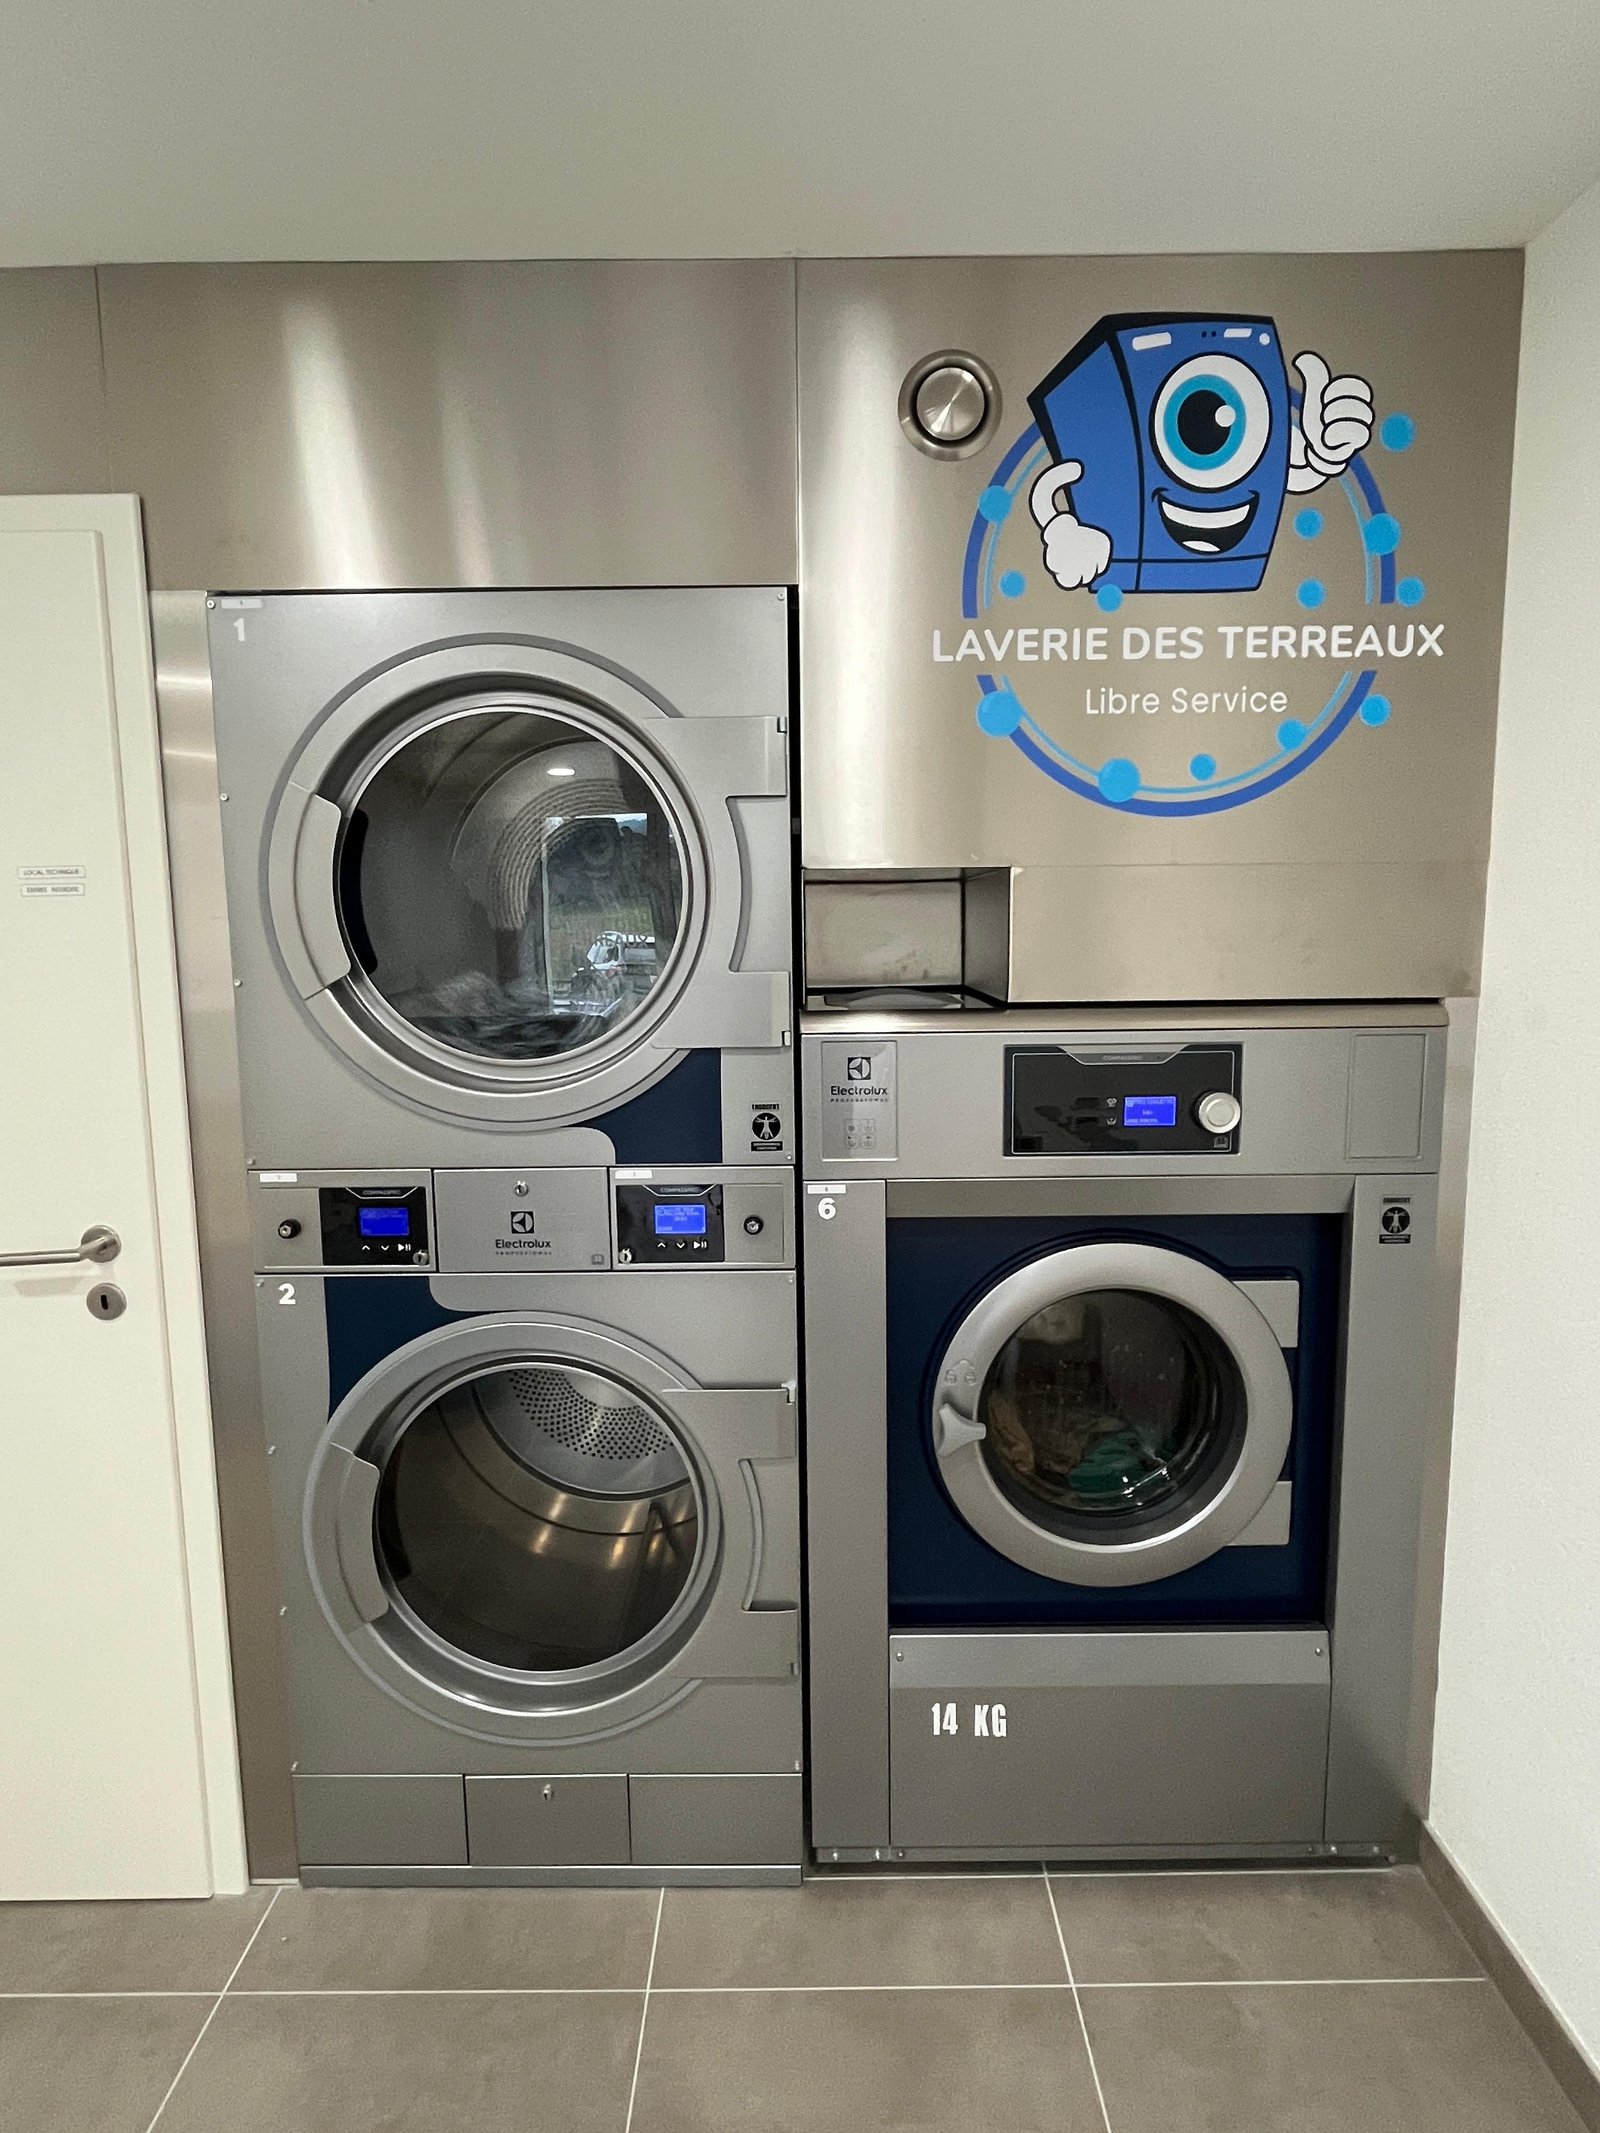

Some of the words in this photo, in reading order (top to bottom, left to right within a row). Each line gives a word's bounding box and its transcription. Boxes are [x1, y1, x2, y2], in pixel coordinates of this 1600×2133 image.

[233, 617, 245, 642] 1
[932, 627, 1108, 662] LAVERIE
[1123, 626, 1204, 660] DES
[1217, 624, 1446, 660] TERREAUX
[1085, 688, 1160, 715] Libre
[1171, 686, 1289, 714] Service
[830, 1085, 888, 1096] Electrolux
[817, 1196, 837, 1220] 6
[495, 1238, 552, 1249] Electrolux
[278, 1282, 297, 1305] 2
[931, 1702, 959, 1736] 14
[974, 1703, 1007, 1737] KG
